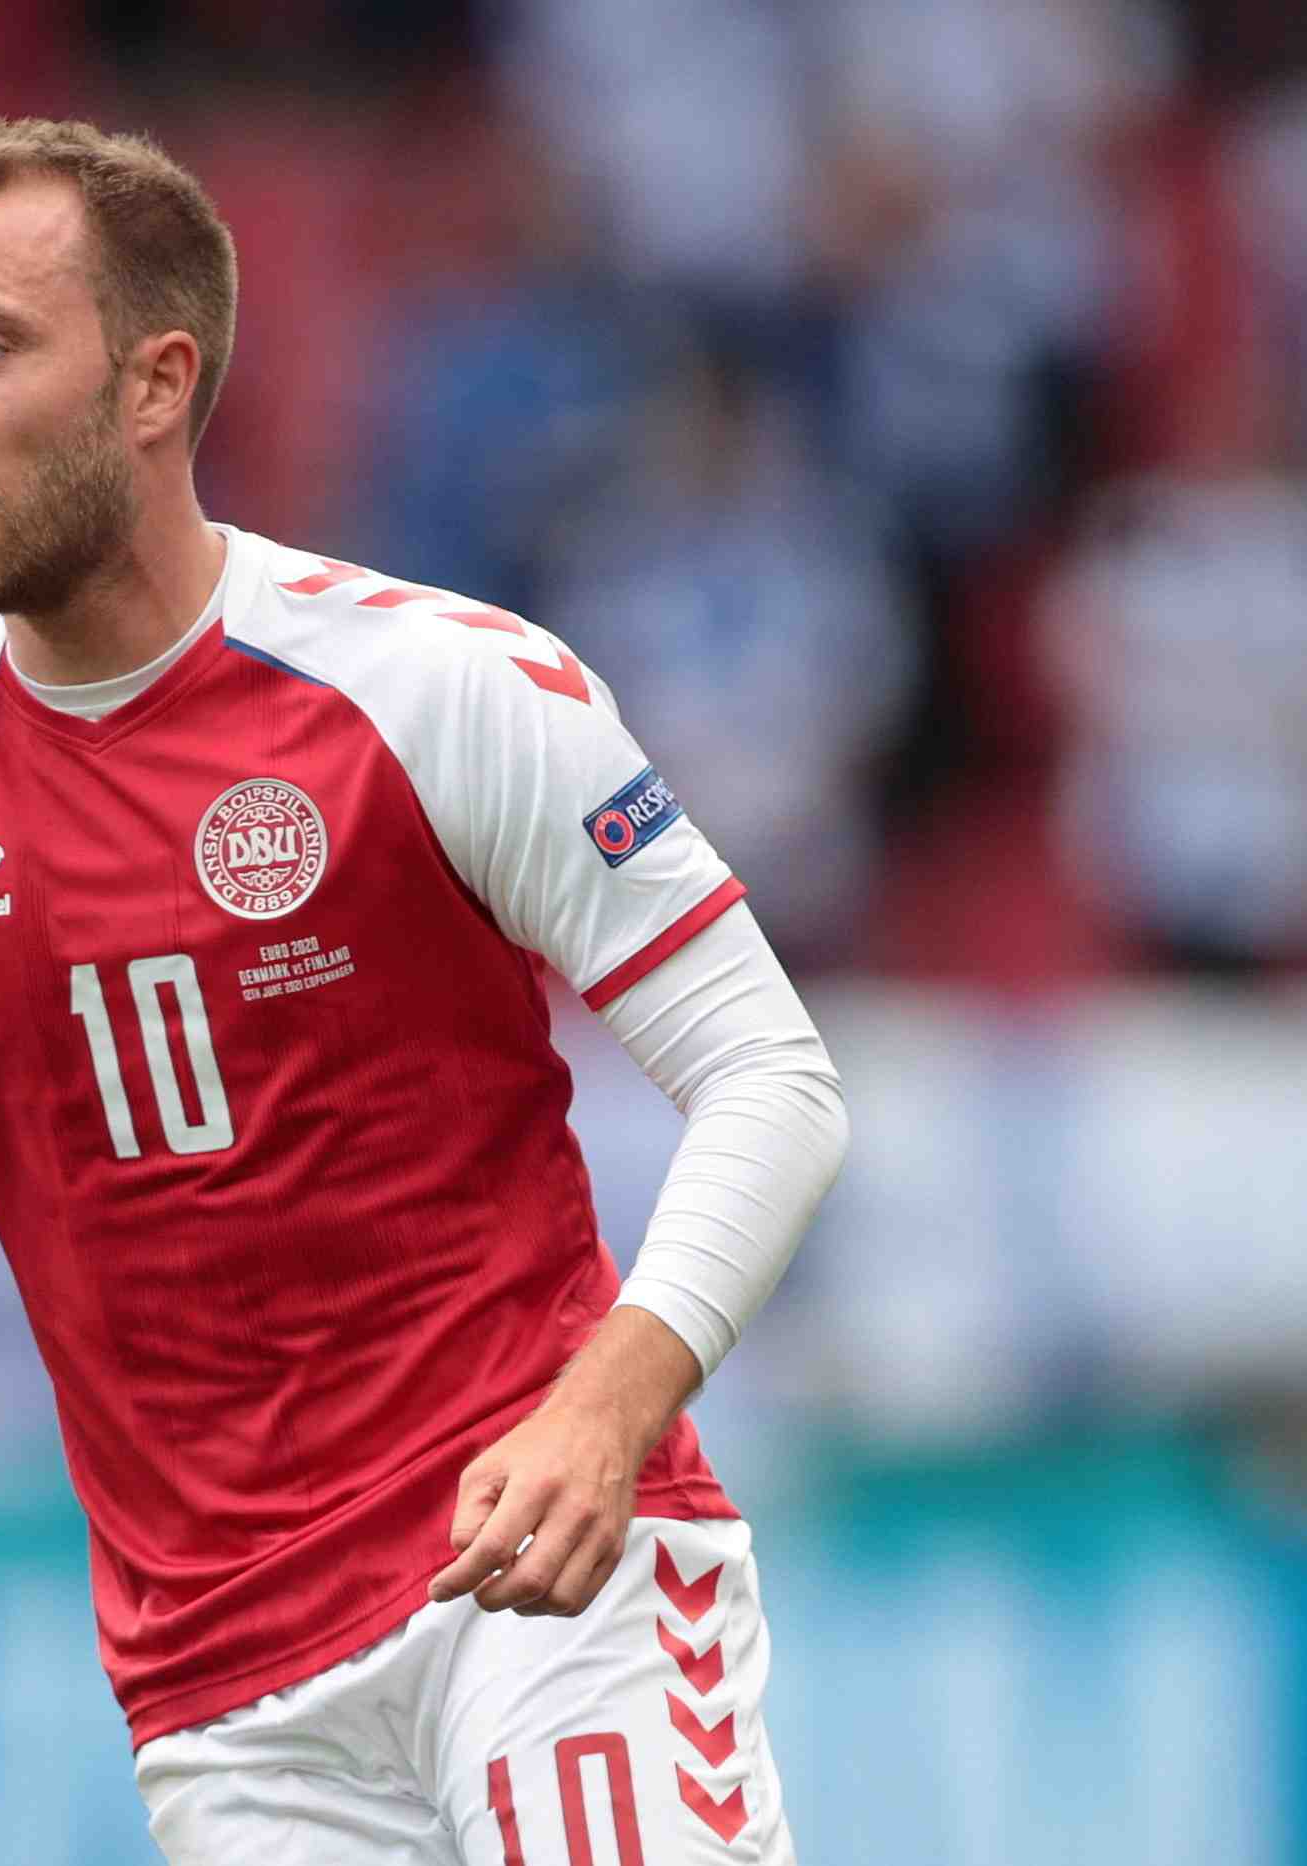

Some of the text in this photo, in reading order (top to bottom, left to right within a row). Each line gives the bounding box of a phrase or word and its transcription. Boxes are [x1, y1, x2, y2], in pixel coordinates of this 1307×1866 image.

[204, 825, 237, 901] DANSK
[227, 826, 299, 868] DBU
[295, 818, 321, 889] UNION
[242, 889, 294, 912] 1889
[238, 963, 291, 986] DENMARK
[304, 946, 350, 973] FINLAND
[260, 936, 319, 962] EURO 2020
[283, 978, 304, 994] 2021
[70, 953, 235, 1160] 10
[487, 1732, 644, 1866] 10
